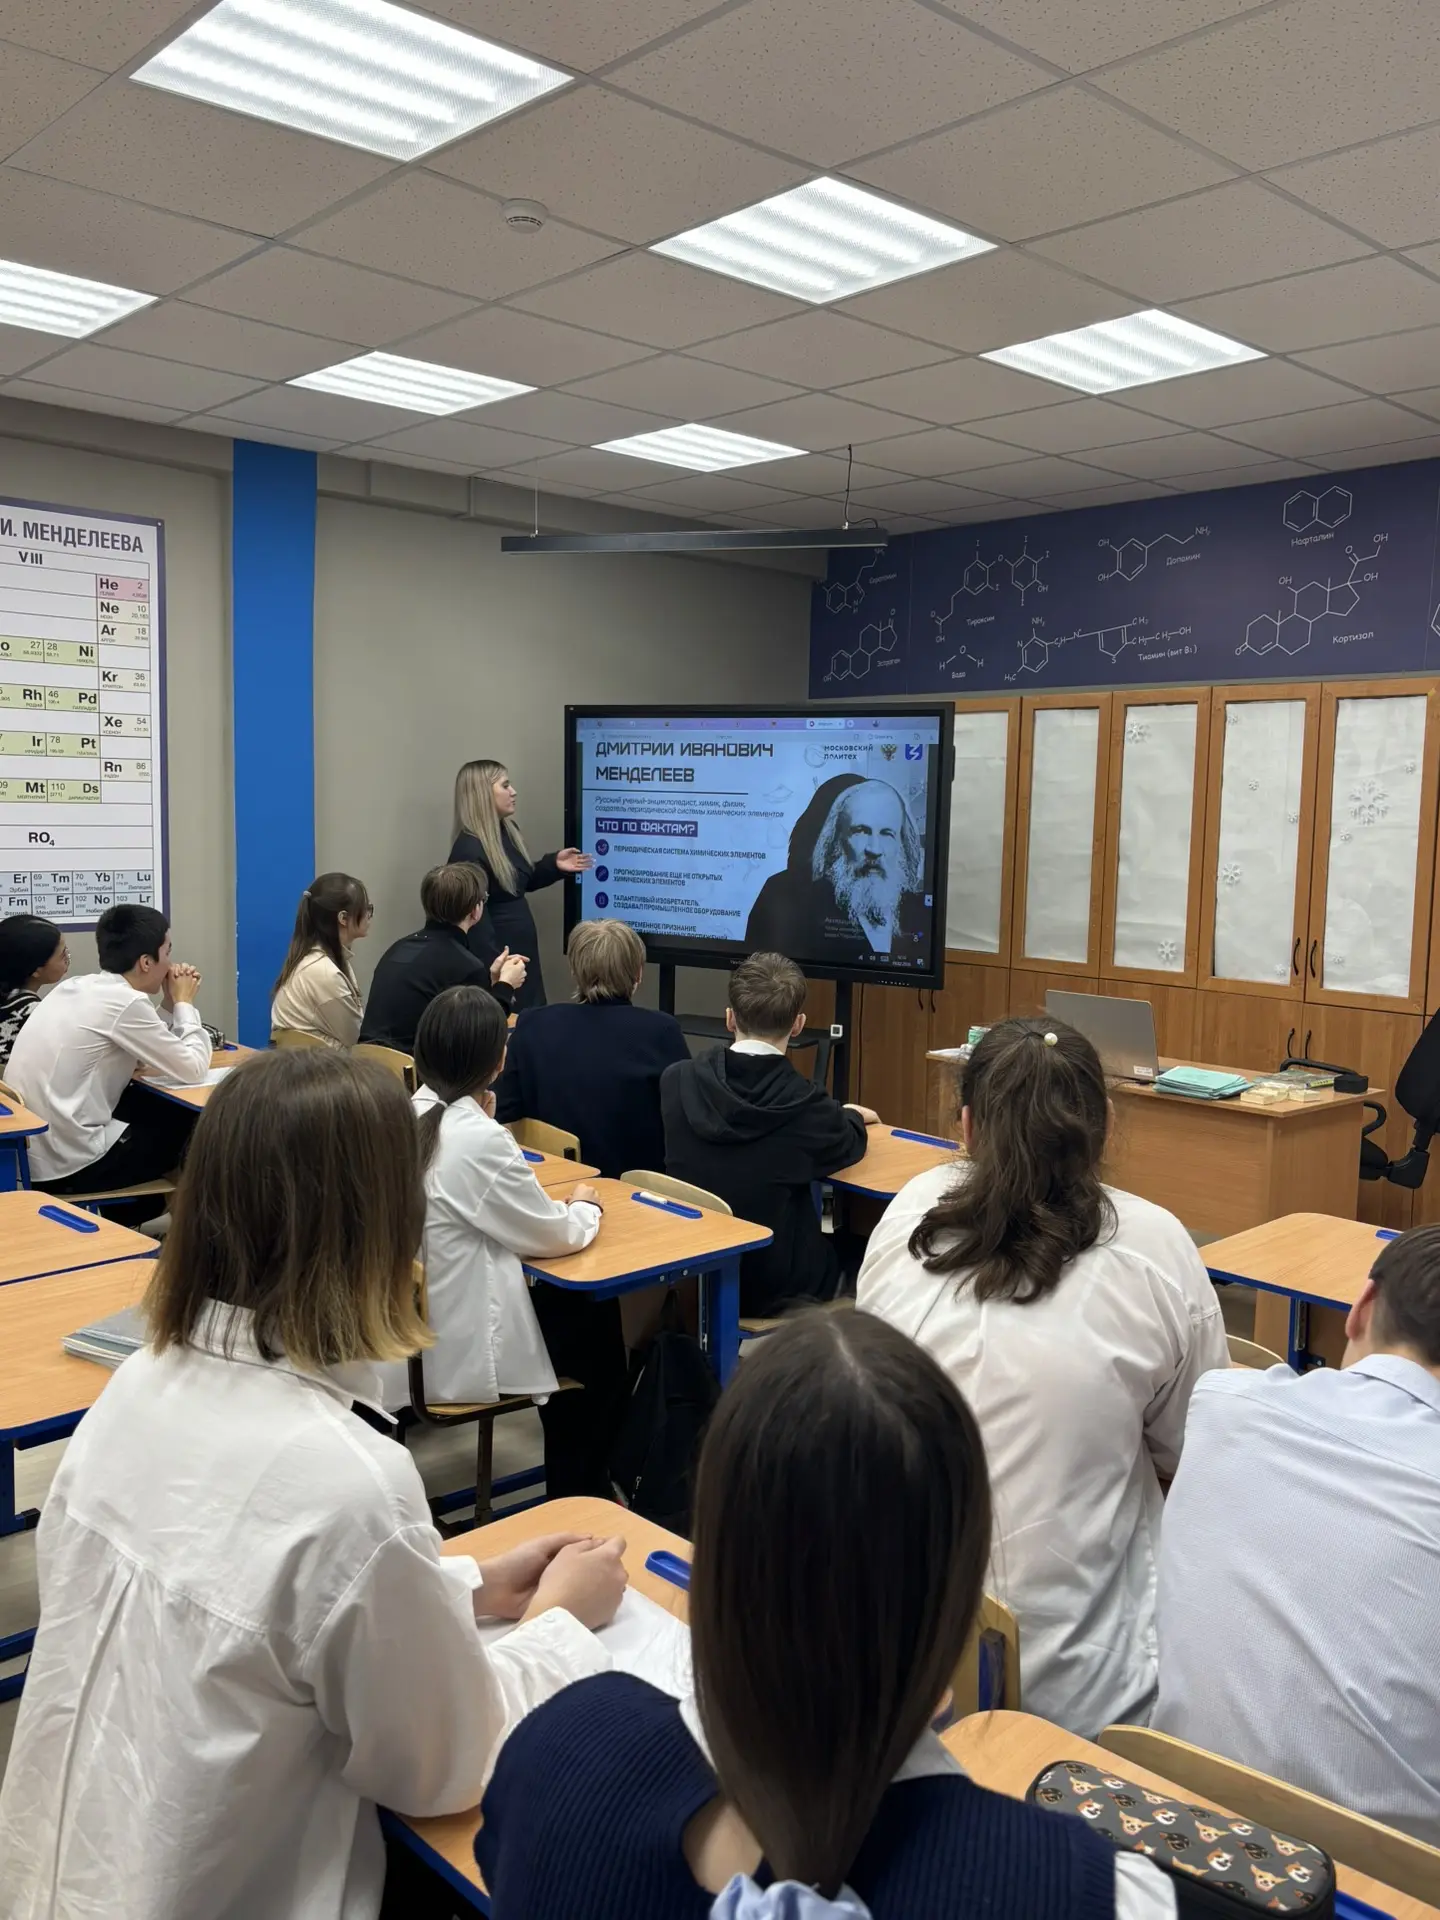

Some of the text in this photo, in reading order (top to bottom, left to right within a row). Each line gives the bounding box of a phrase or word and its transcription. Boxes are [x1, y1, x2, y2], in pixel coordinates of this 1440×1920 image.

[23, 521, 144, 553] МЕНДЕЛЕЕВА
[1099, 538, 1110, 547] OH
[1291, 532, 1335, 547] Нафталин
[1373, 533, 1389, 543] OH
[19, 551, 43, 565] VIII
[1166, 553, 1201, 566] Допамин
[1098, 573, 1109, 582] OH
[1278, 576, 1293, 585] OH
[1363, 572, 1379, 582] OH
[100, 578, 143, 590] He 2
[101, 601, 147, 614] Ne 10
[101, 624, 147, 636] Ar 18
[1179, 626, 1192, 635] OH
[1332, 631, 1374, 645] Кортизол
[30, 641, 41, 649] 27
[47, 643, 58, 651] 28
[79, 645, 94, 657] Ni
[102, 671, 145, 682] Kr 36
[23, 689, 42, 701] Rh
[79, 693, 97, 705] Pd
[104, 716, 123, 728] Xe
[32, 736, 43, 747] Ir
[81, 738, 96, 749] Pt
[680, 743, 773, 758] ИВАНОВИЧ
[104, 762, 122, 772] Rn
[596, 767, 695, 784] МЕНДЕЛЕЕВ
[25, 782, 45, 793] Mt
[51, 783, 66, 791] 110
[83, 784, 99, 794] Ds
[595, 796, 621, 805] Русский
[595, 805, 626, 813] создатель
[627, 806, 676, 814] периодической
[706, 809, 746, 817] химических
[598, 820, 695, 835] ЧТО ПО ФАКТАМ?
[29, 832, 55, 846] RO4
[613, 845, 662, 854] ПЕРИОДИЧЕСКАЯ
[690, 849, 730, 858] ХИМИЧЕСКИХ
[730, 851, 766, 859] ЭЛЕМЕНТОВ
[13, 874, 27, 884] Er
[51, 873, 70, 883] Tm
[95, 872, 111, 882] Yb
[137, 872, 151, 881] Lu
[613, 868, 669, 878] ПРОГНОЗИРОВАНИЕ
[691, 873, 723, 881] ОТКРЫТЫХ
[613, 876, 686, 886] ХИМИЧЕСКИХ ЭЛЕМЕНТОВ
[8, 896, 28, 906] Fm
[56, 895, 70, 905] Er
[94, 895, 110, 905] No
[139, 894, 152, 903] Lr
[613, 894, 655, 903] ТАЛАНТЛИВЫЙ
[613, 901, 741, 917] СОЗДАВАЛ ПРОМЫШЛЕННОЕ ОБОРУДОВАНИЕ
[662, 923, 697, 932] ПРИЗНАНИЕ
